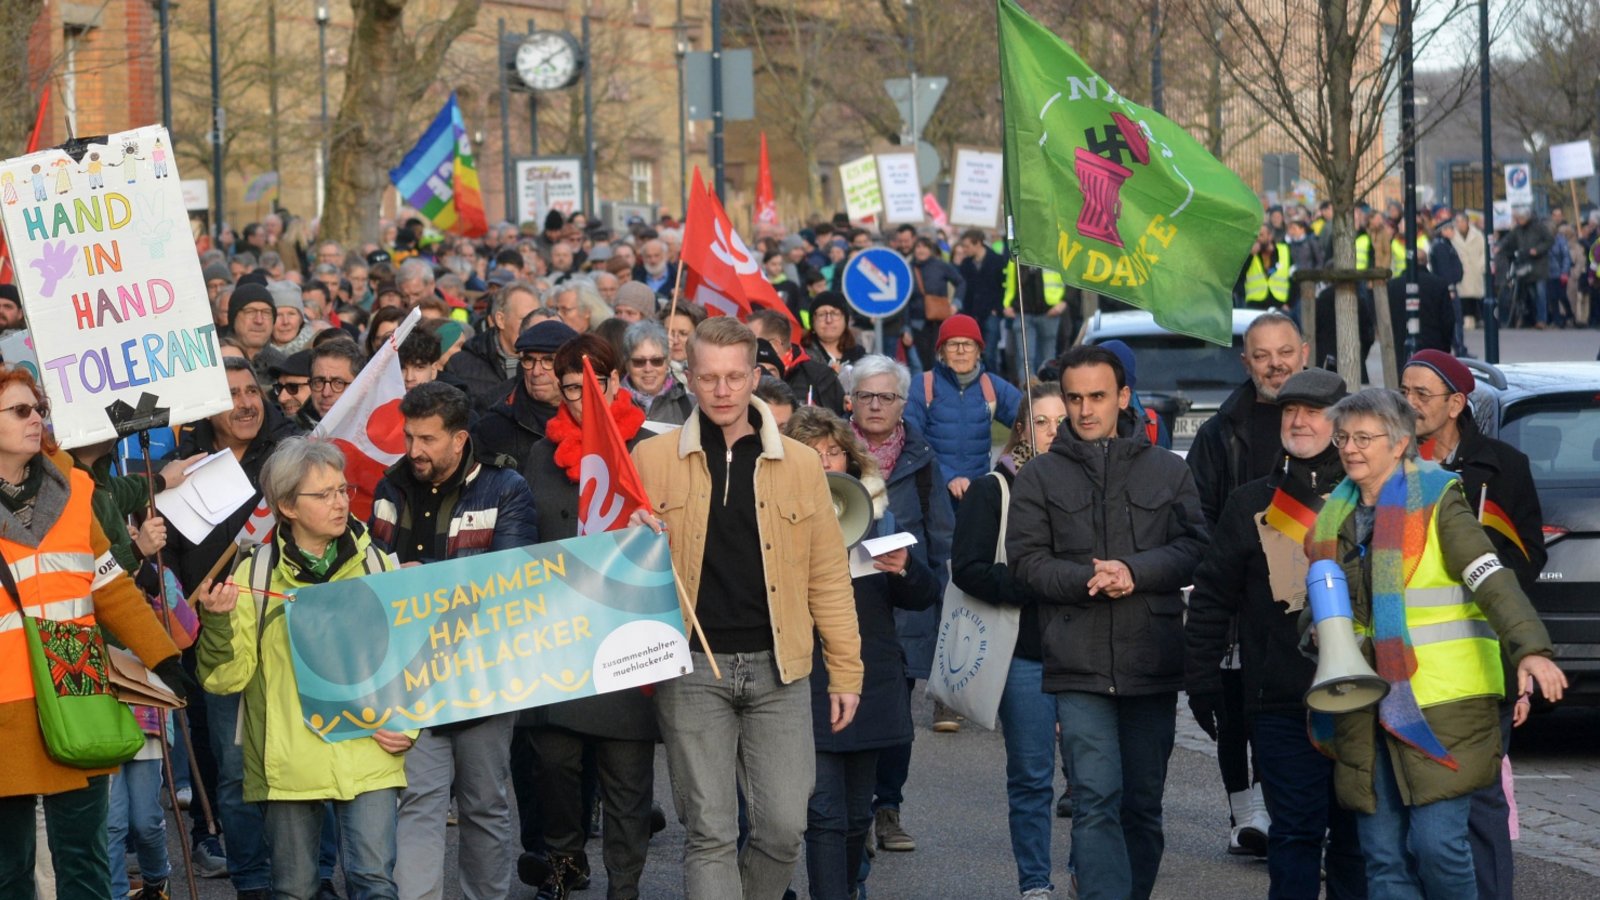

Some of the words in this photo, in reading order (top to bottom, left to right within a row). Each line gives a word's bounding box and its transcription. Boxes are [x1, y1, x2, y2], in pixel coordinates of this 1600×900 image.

[23, 193, 132, 241] HAND
[83, 240, 123, 276] IN
[1082, 214, 1178, 287] DANKE
[72, 278, 175, 330] HAND
[45, 323, 218, 404] TOLERANT
[391, 553, 567, 628] ZUSAMMEN
[429, 593, 548, 651] HALTEN
[403, 615, 593, 693] MÜHLACKER
[602, 637, 679, 672] zusammenhalten-
[612, 651, 674, 679] muehlacker.de
